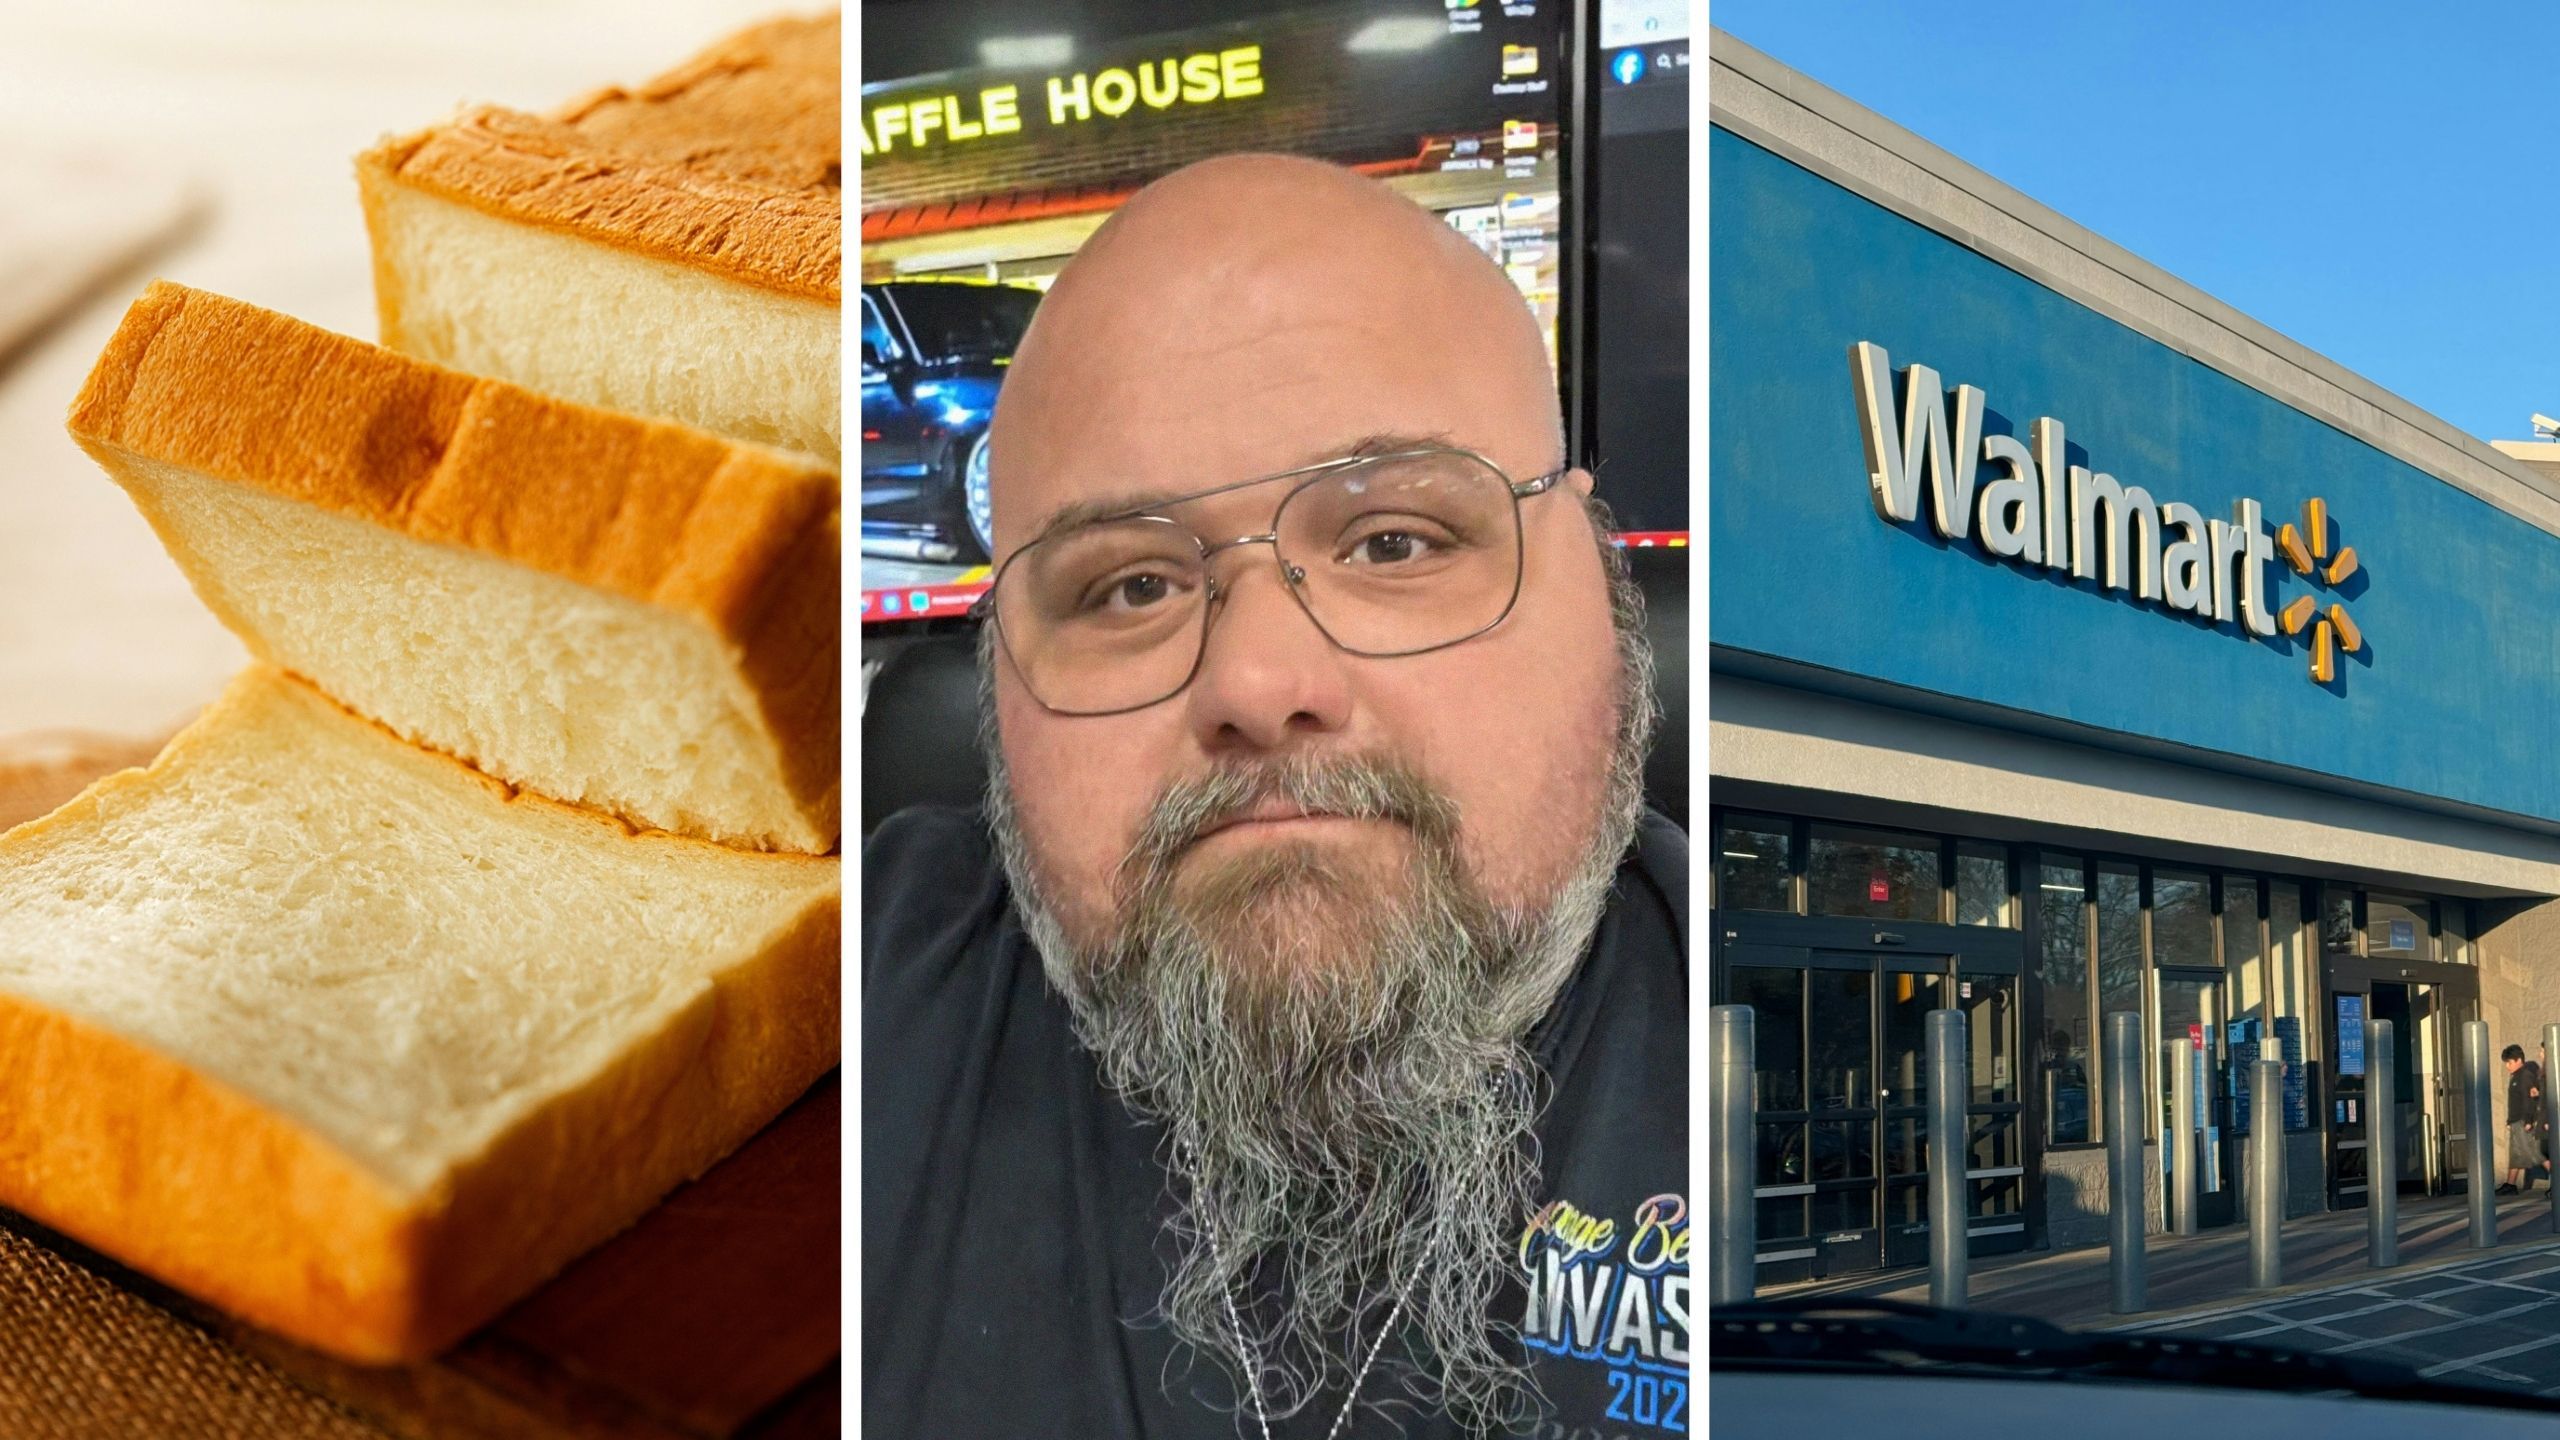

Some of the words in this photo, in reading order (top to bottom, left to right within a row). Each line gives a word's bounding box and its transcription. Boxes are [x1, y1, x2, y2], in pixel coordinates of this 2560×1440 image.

[1047, 46, 1264, 125] HOUSE
[1848, 340, 2276, 637] Walmart
[1606, 1370, 1688, 1432] 202
